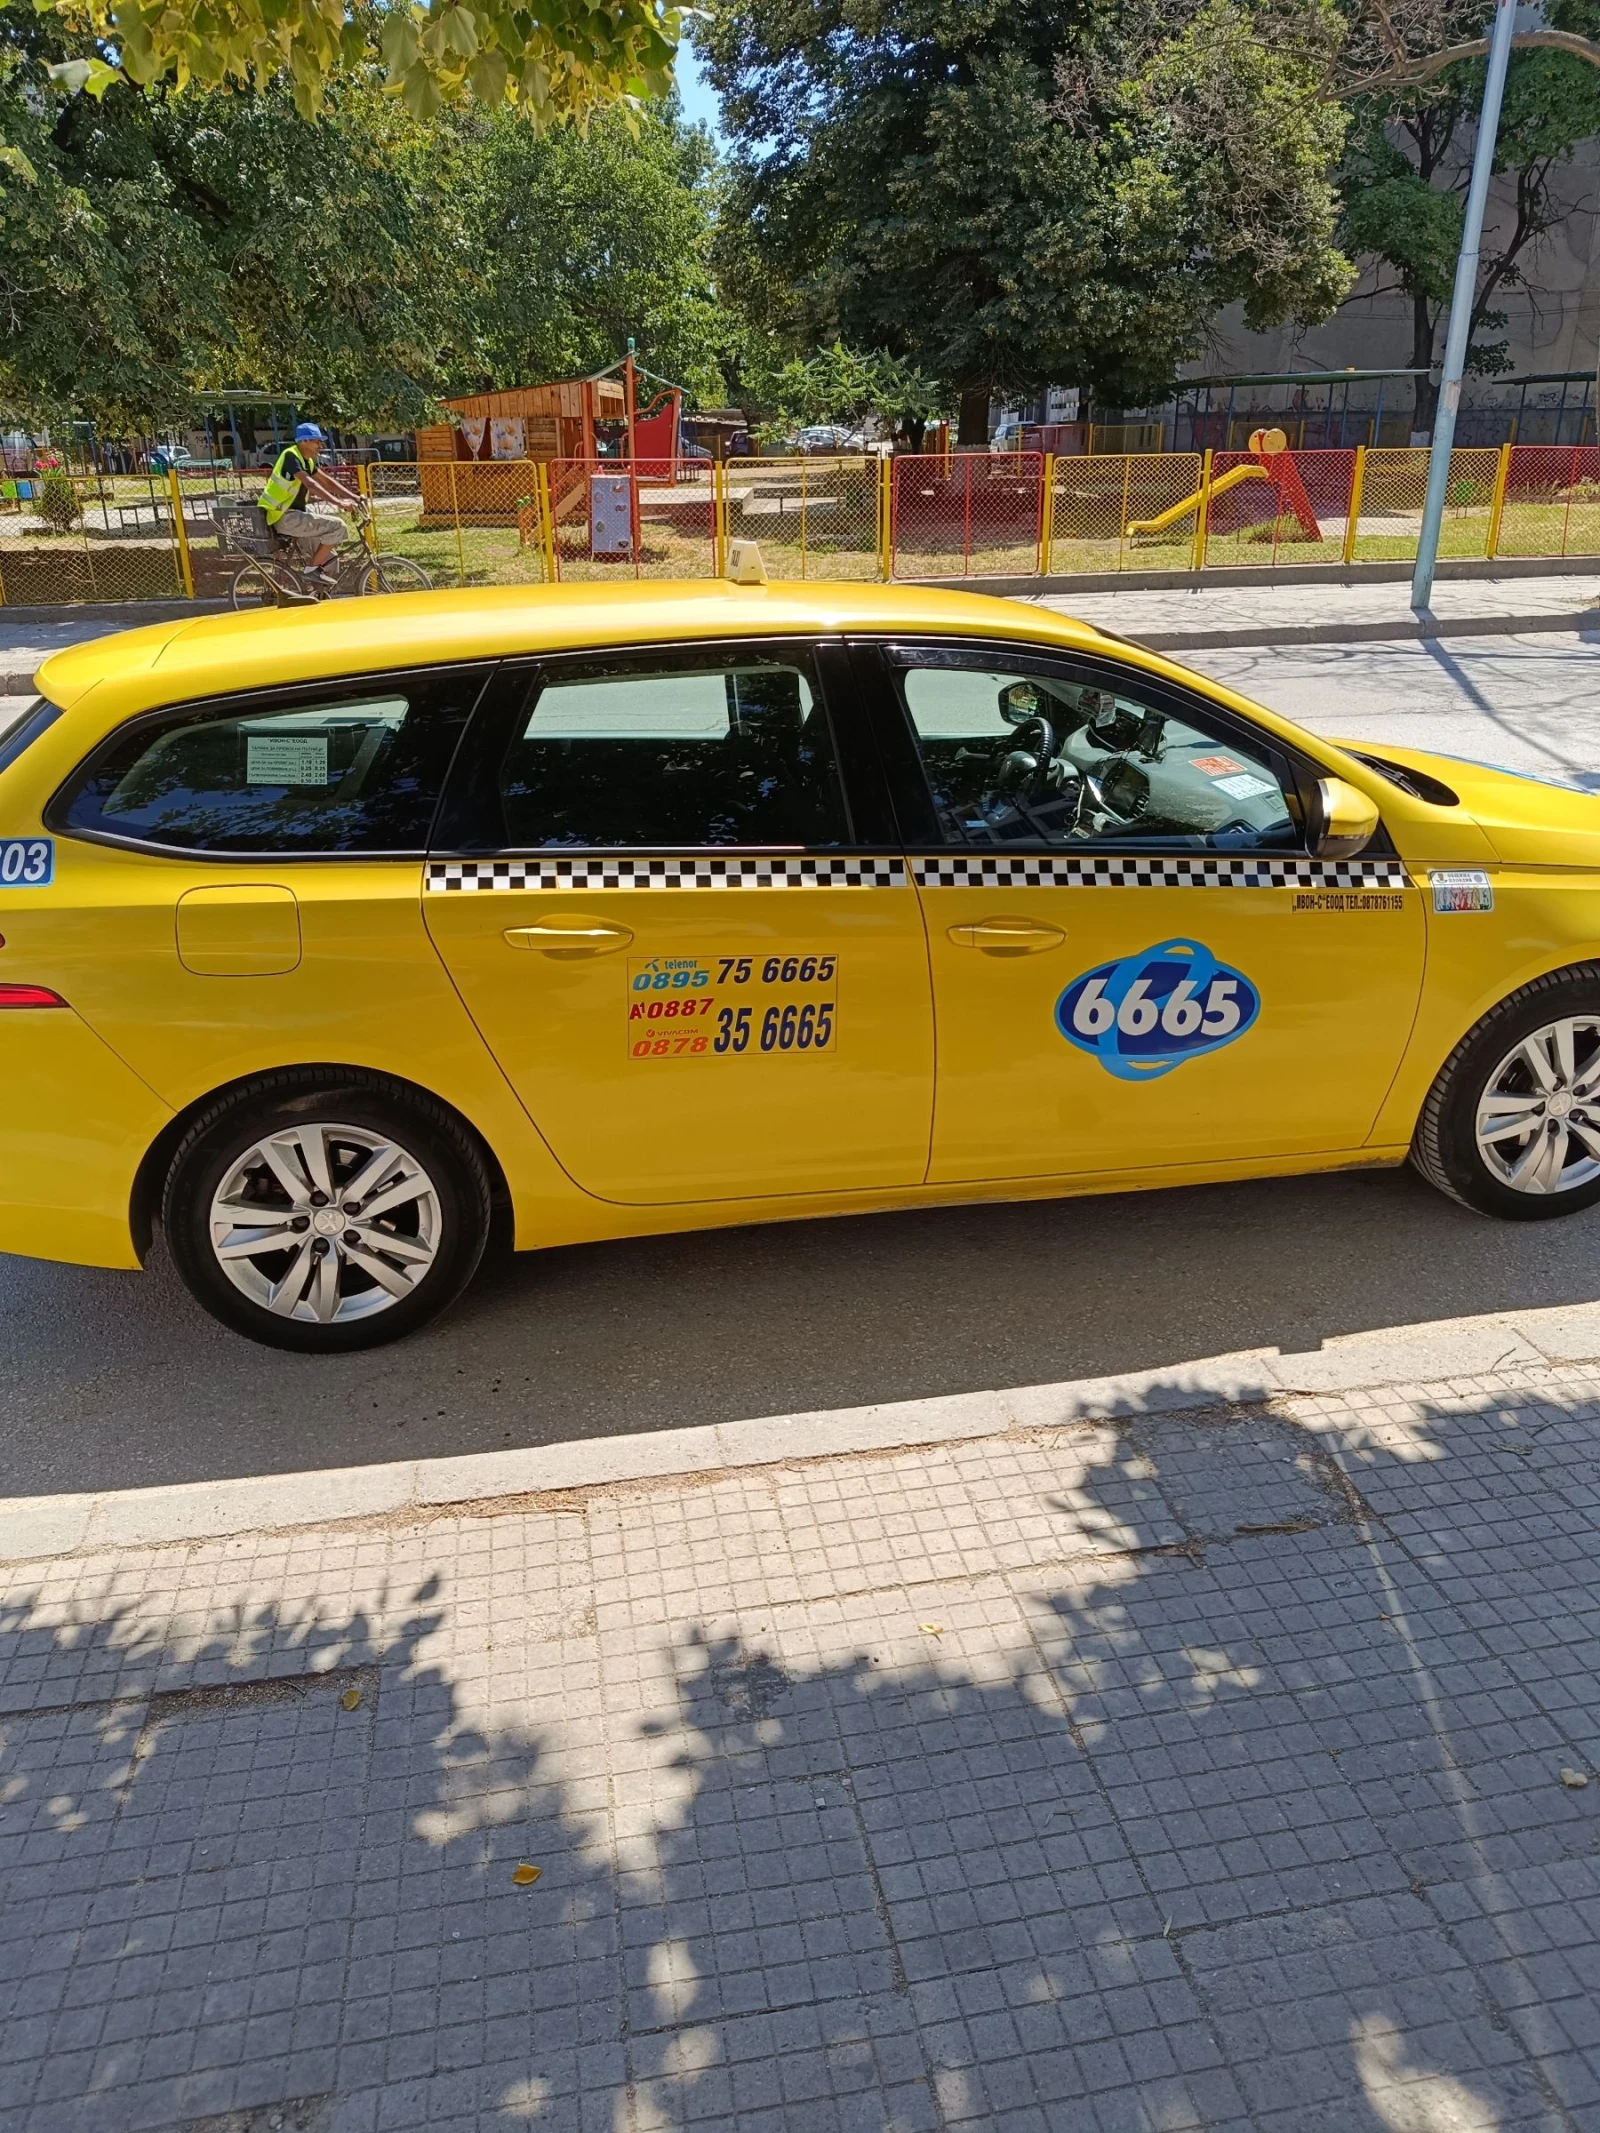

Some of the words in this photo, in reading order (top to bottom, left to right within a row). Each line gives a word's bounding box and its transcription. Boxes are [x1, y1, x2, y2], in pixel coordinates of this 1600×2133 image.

[0, 842, 48, 881] 03
[632, 970, 710, 991] 0895
[716, 958, 753, 984] 75
[761, 957, 837, 983] 6665
[664, 959, 698, 970] telenor
[647, 998, 715, 1019] 0887
[1073, 979, 1241, 1037] 6665
[632, 1036, 709, 1057] 0878
[713, 1007, 753, 1053] 35
[760, 1003, 834, 1051] 6665
